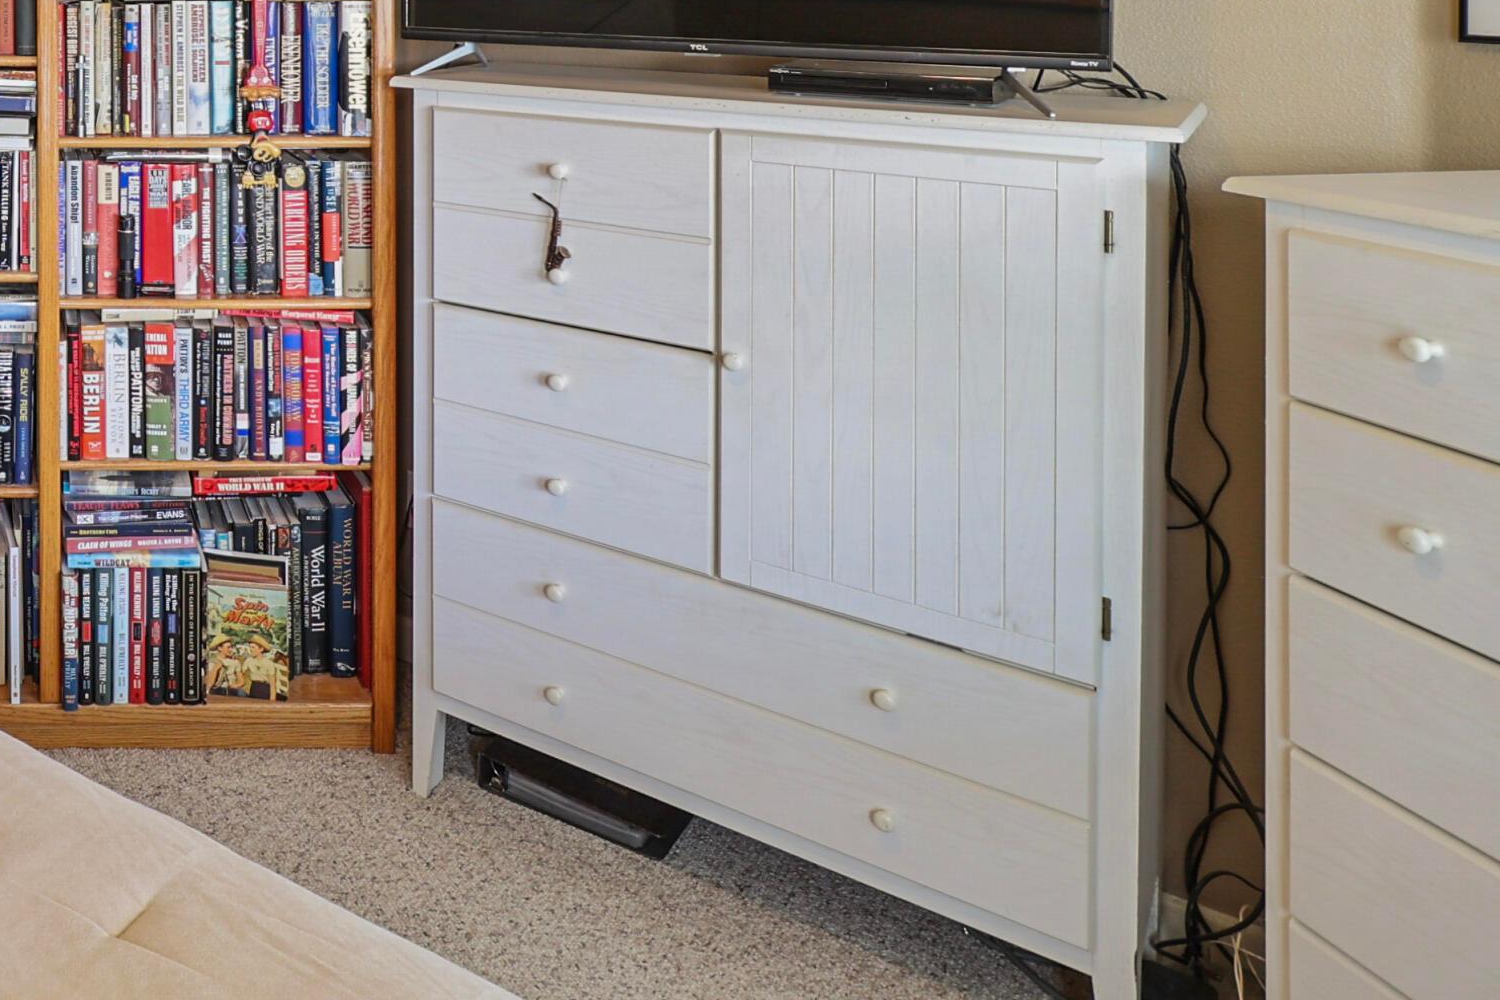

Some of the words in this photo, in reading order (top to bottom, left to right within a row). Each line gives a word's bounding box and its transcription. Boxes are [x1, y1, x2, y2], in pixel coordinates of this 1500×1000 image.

[316, 24, 329, 40] IKE
[281, 35, 300, 103] EISENHOWER
[316, 44, 329, 64] THE
[348, 13, 368, 113] Eisenhower
[316, 66, 329, 109] SOLDIER
[70, 166, 78, 201] Abandon
[182, 174, 191, 195] PEARL
[362, 183, 371, 202] THE
[70, 203, 78, 223] Ship!
[182, 199, 191, 230] HARBOR
[348, 183, 359, 219] WORLD
[256, 211, 264, 242] WORLD
[285, 193, 306, 246] MARCHING
[348, 222, 359, 244] WAR
[362, 204, 371, 244] SECOND
[256, 245, 264, 264] WAR
[285, 250, 306, 290] ORDERS
[180, 339, 189, 373] PATTON'S
[202, 340, 210, 360] PATTON
[237, 331, 245, 363] PATTON
[114, 354, 125, 403] BERLIN
[202, 363, 210, 374] AND
[223, 355, 233, 393] PARTNERS
[290, 353, 300, 373] TOM
[132, 372, 142, 412] PATTON
[180, 378, 189, 409] THIRD
[202, 376, 210, 397] ROMMEL
[290, 377, 300, 422] BROKAW
[84, 374, 100, 434] BERLIN
[180, 412, 189, 442] ARMY
[223, 406, 233, 444] COMMAND
[78, 541, 97, 549] CLASH
[100, 541, 108, 549] OF
[110, 541, 131, 549] WINGS
[342, 518, 352, 565] WORLD
[311, 545, 324, 586] World
[334, 541, 342, 585] ALBUM
[99, 573, 108, 596] Killing
[342, 568, 352, 597] WAR
[99, 598, 108, 622] Patton
[225, 611, 274, 629] Marty
[235, 598, 268, 611] Spin
[311, 590, 324, 619] War
[65, 609, 76, 656] NUCLEAR
[311, 623, 324, 631] II
